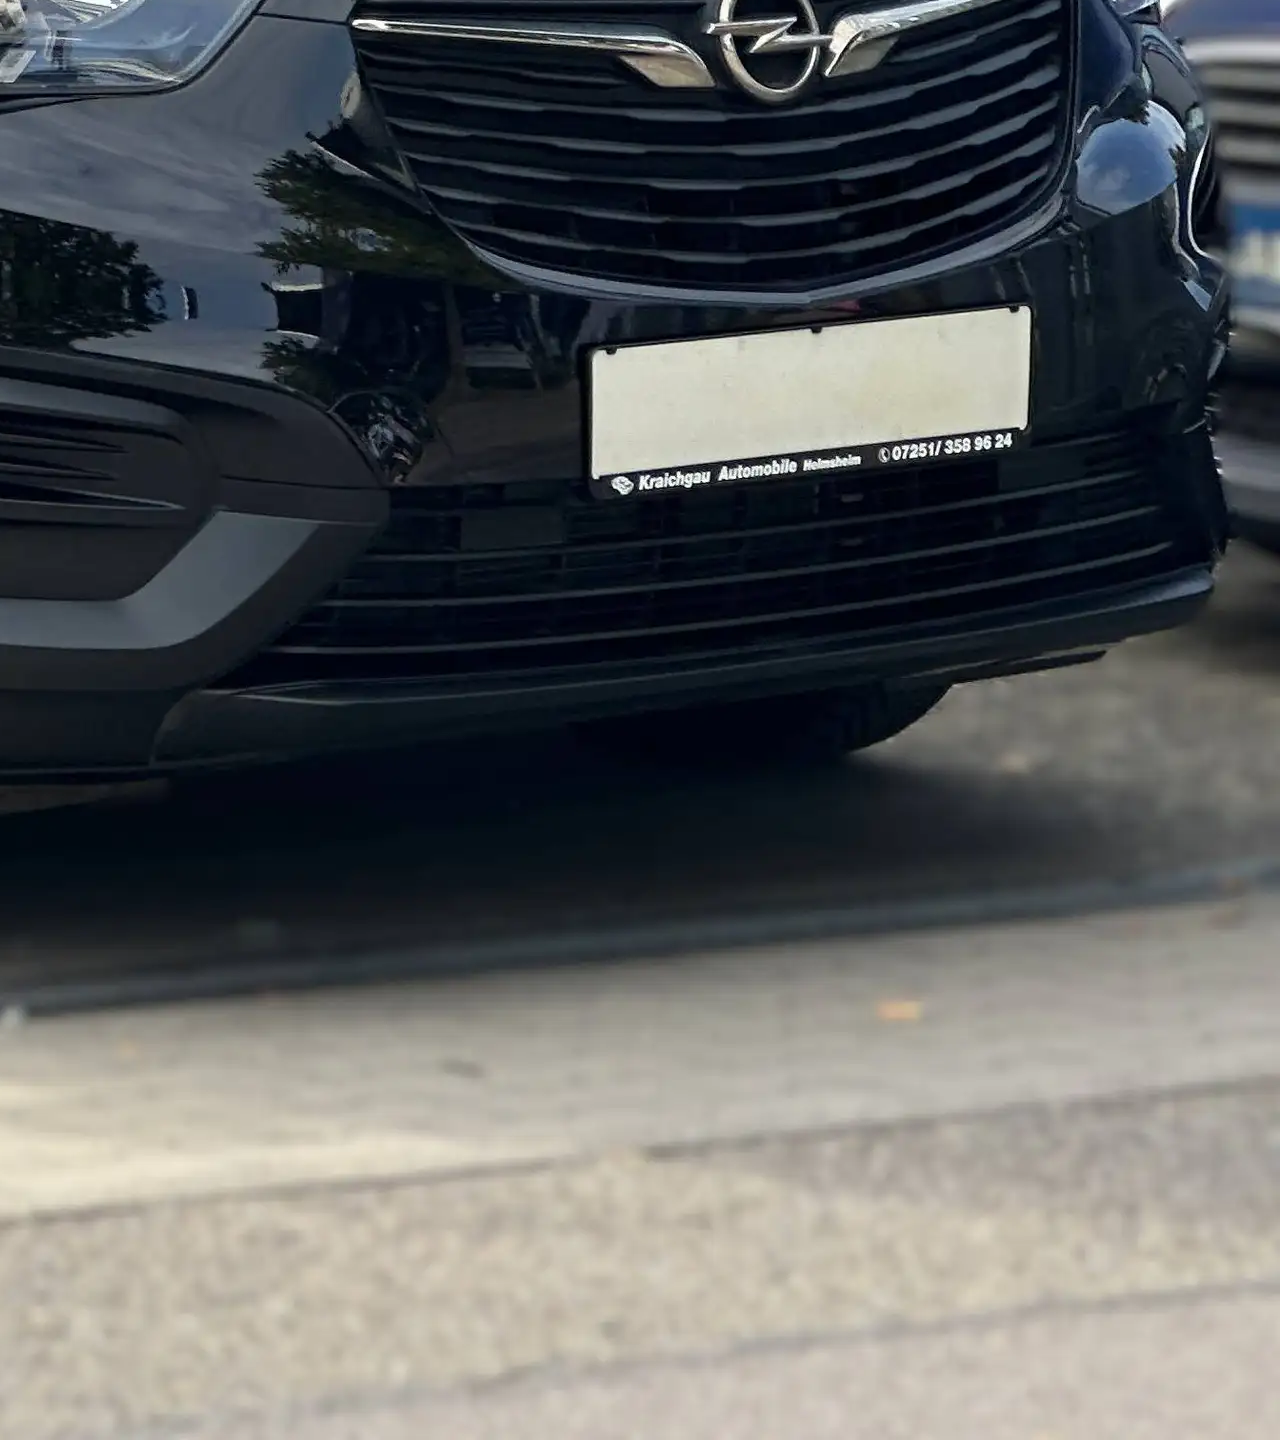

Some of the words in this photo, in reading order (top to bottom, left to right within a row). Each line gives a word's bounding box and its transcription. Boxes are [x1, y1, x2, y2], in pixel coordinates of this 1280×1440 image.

[638, 470, 711, 491] Kraichgau
[718, 458, 797, 481] Automobile
[891, 441, 941, 461] 07251/
[944, 439, 972, 455] 358
[975, 435, 992, 451] 96
[995, 433, 1014, 449] 24
